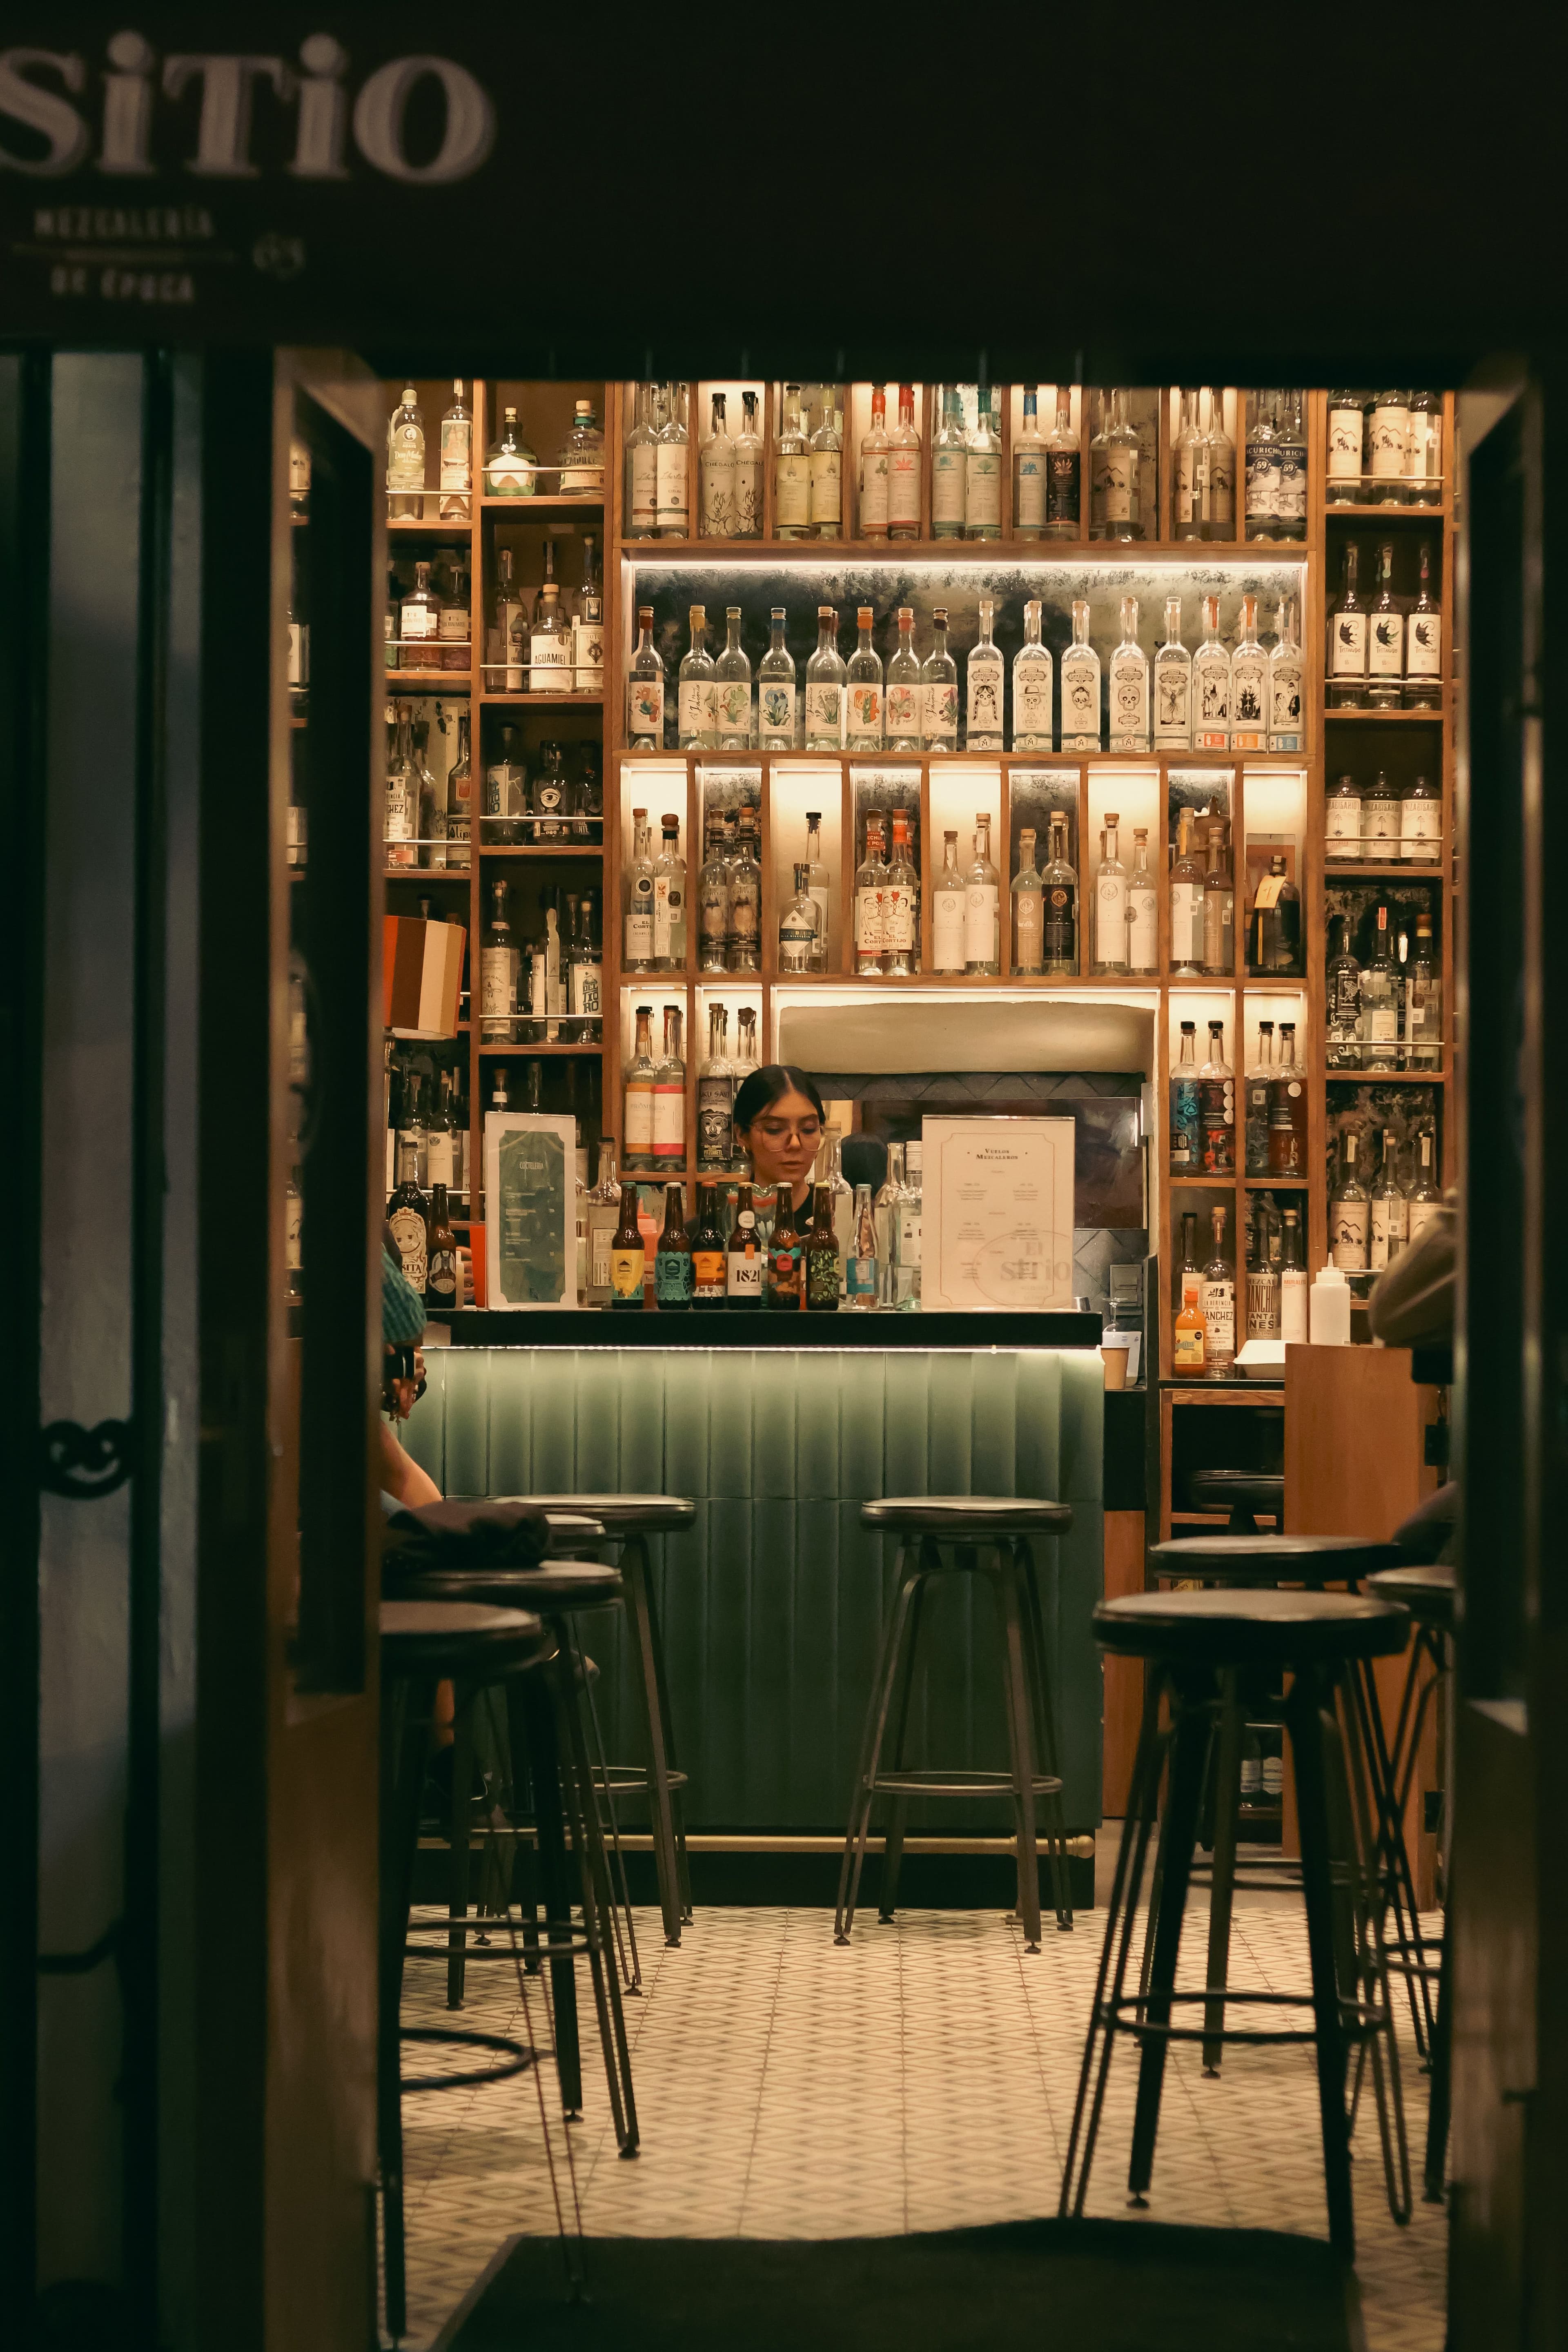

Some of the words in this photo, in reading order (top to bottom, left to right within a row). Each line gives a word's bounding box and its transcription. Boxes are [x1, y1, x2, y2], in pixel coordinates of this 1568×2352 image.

[1256, 461, 1267, 469] 59
[1283, 464, 1294, 472] 59
[534, 653, 566, 665] AGUAMIEL
[737, 1270, 760, 1282] 1821
